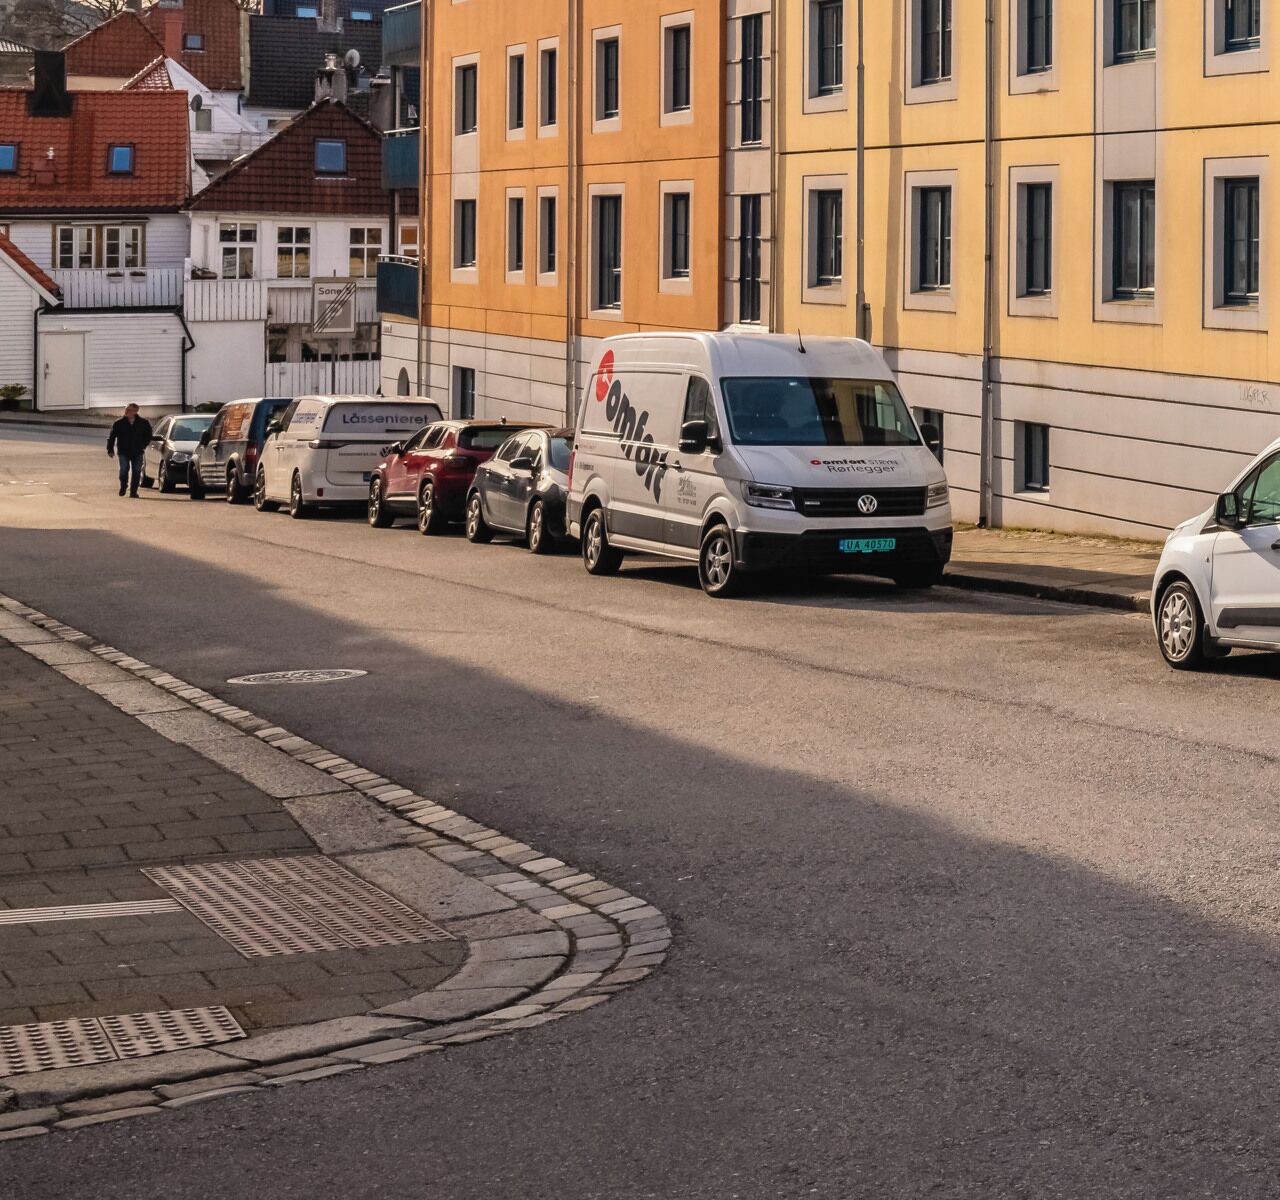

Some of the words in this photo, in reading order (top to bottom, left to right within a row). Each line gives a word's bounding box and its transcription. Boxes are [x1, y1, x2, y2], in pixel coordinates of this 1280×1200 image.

[343, 413, 428, 424] Låssenteret
[827, 465, 897, 474] Rørlegger
[846, 540, 860, 550] UA
[864, 539, 895, 549] 40570
